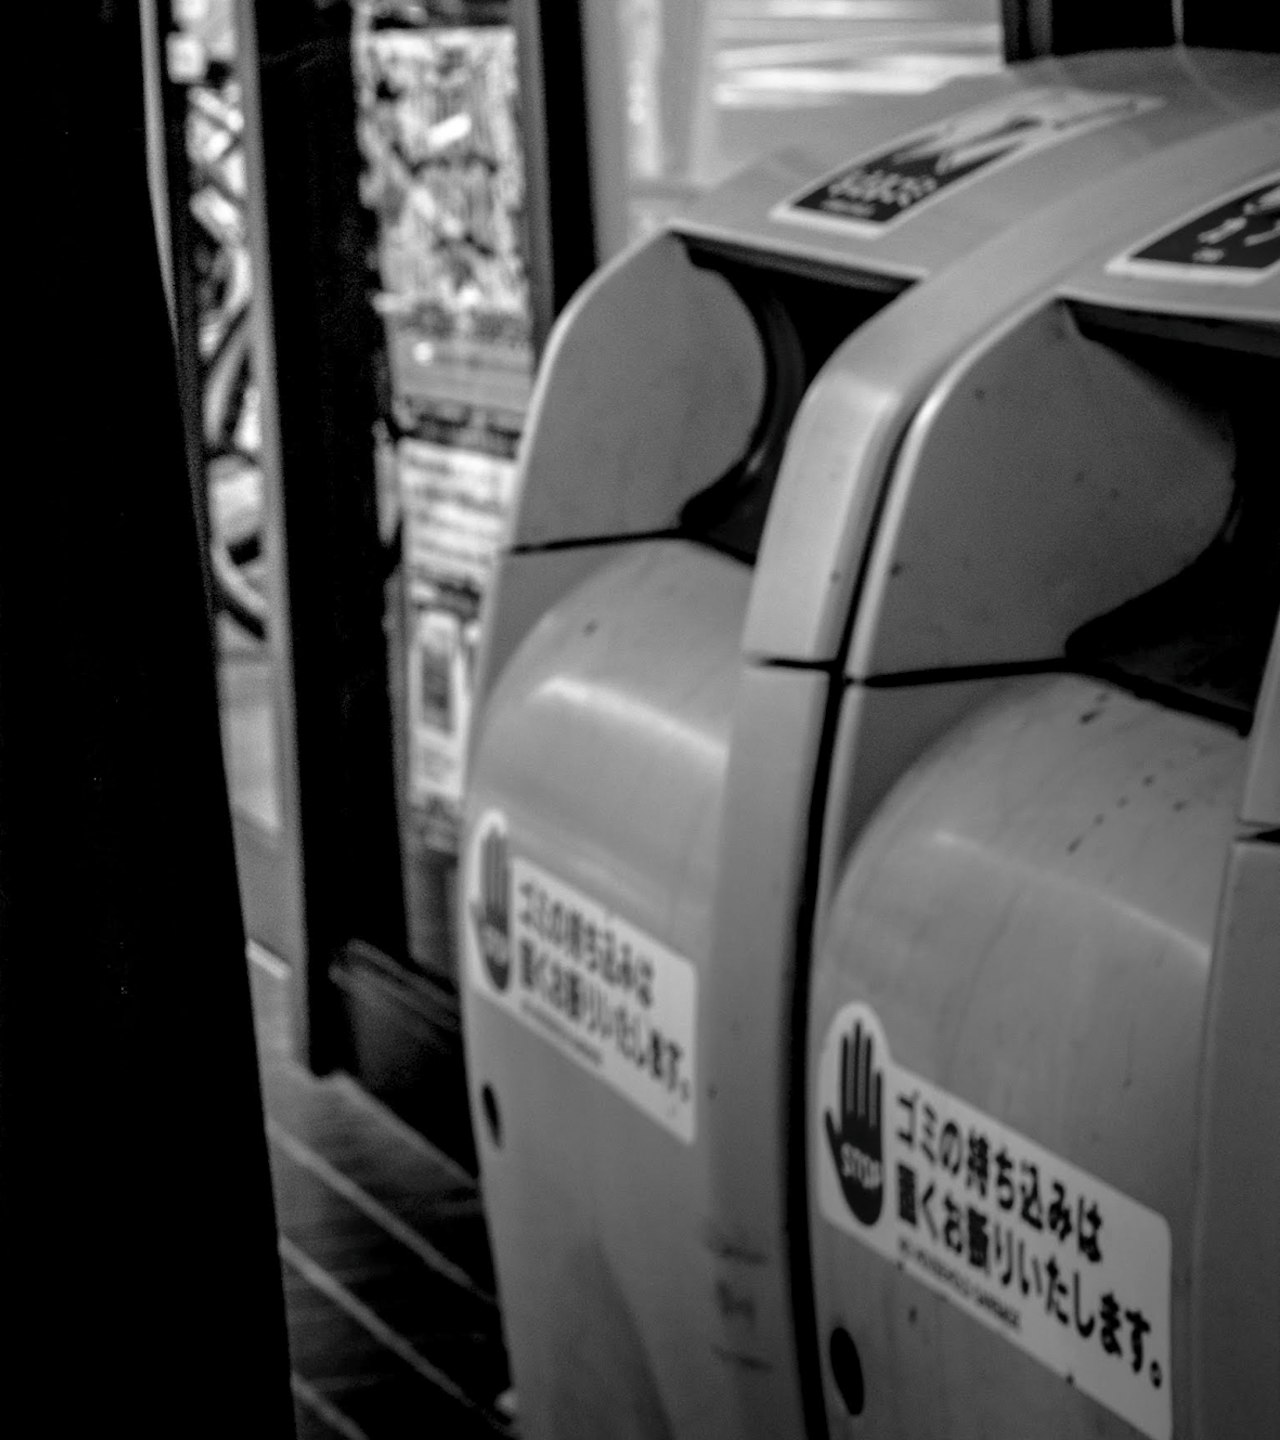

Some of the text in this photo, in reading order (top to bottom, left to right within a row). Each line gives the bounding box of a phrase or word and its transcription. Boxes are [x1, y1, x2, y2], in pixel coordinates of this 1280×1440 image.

[897, 1092, 1102, 1263] ゴミの持ち込みは
